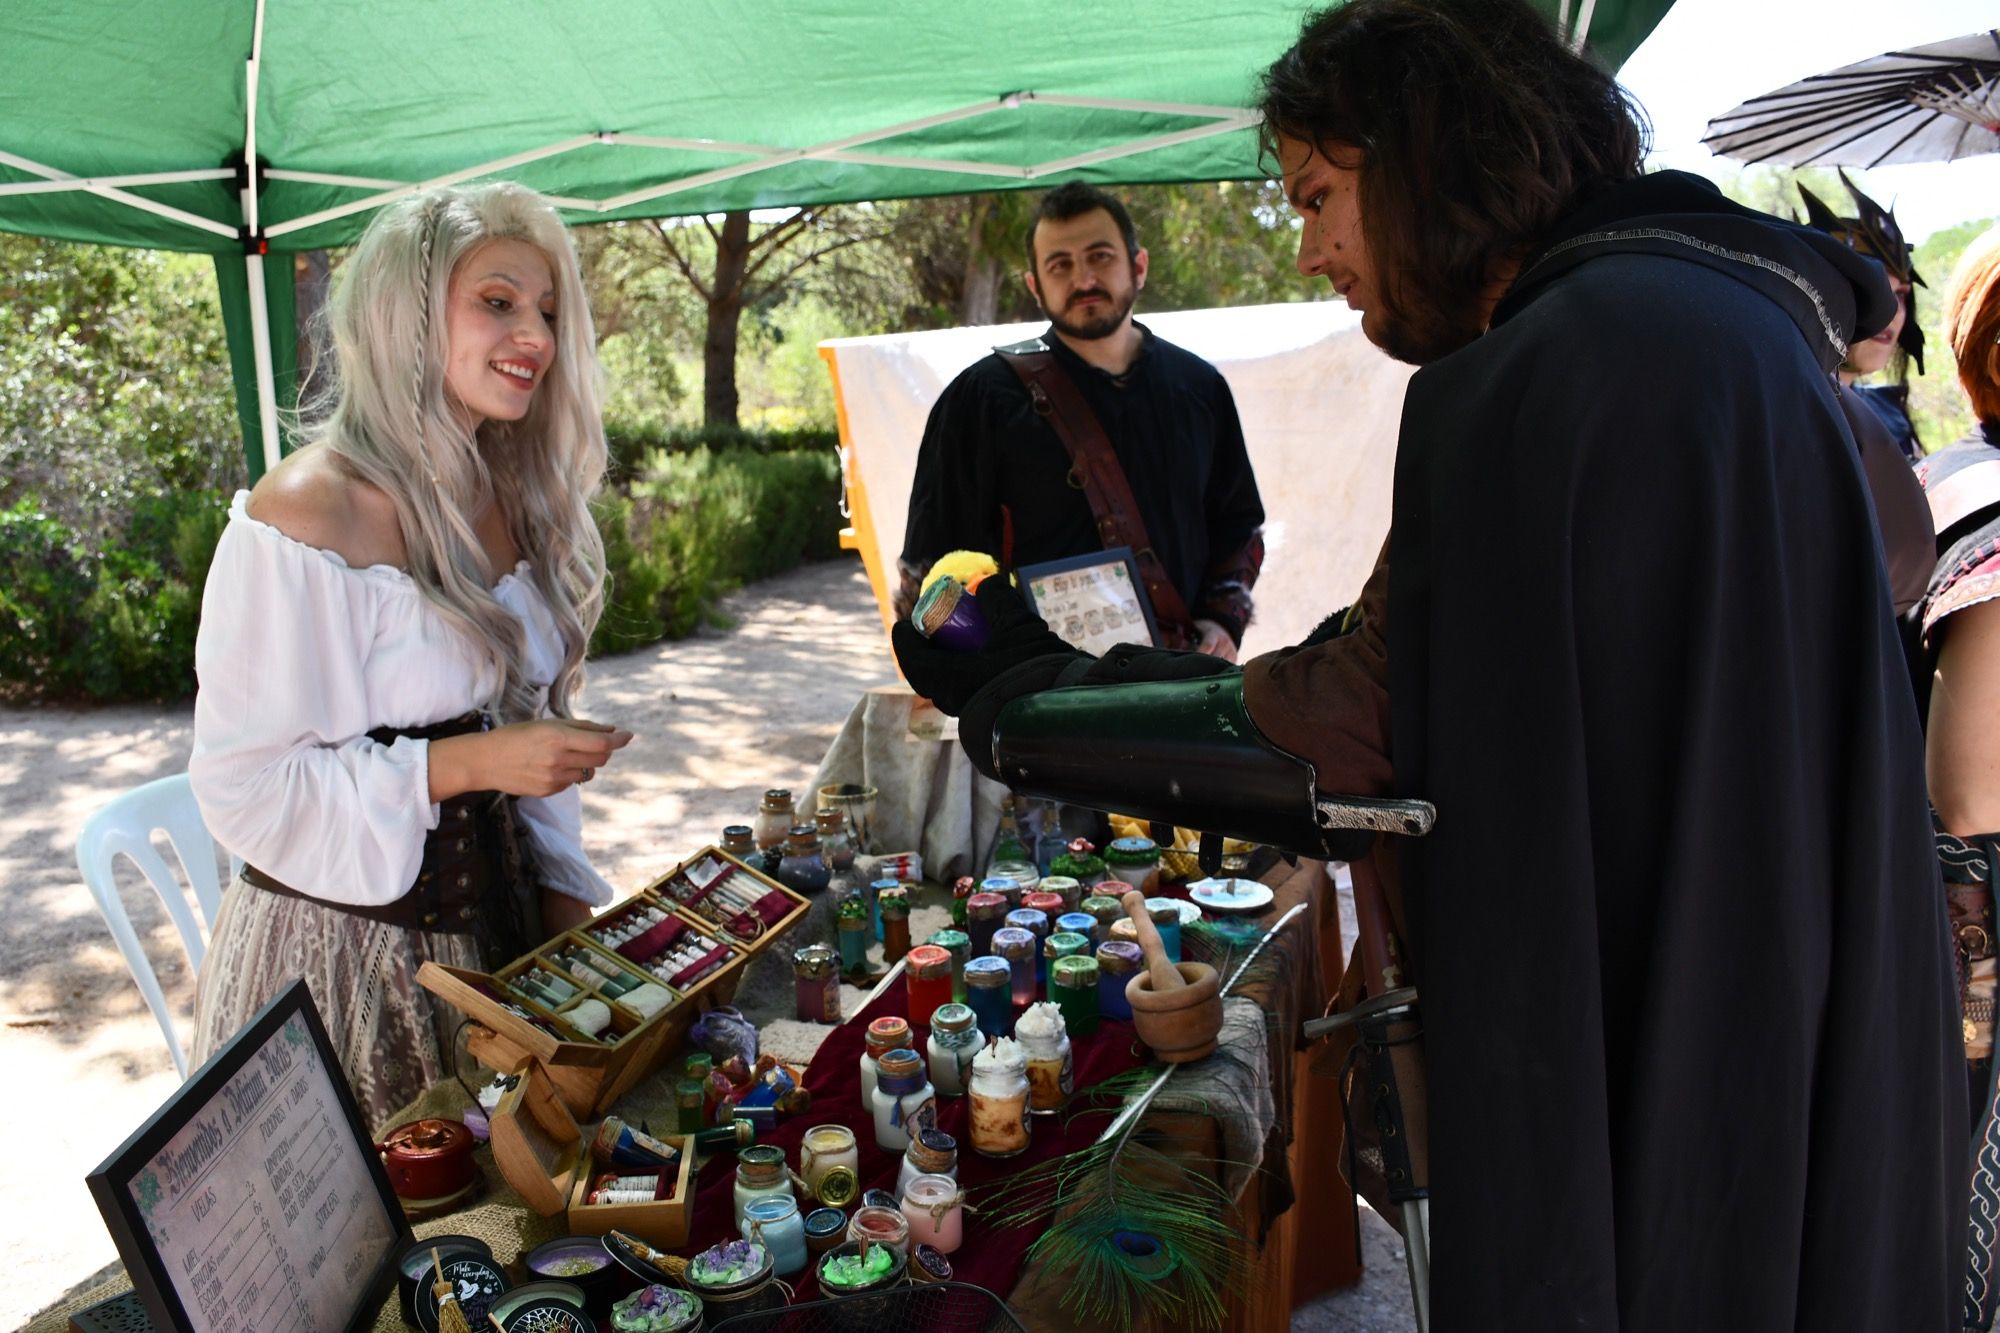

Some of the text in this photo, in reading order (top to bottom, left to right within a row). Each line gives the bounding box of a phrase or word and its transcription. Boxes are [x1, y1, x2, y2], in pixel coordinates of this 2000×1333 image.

[285, 1096, 292, 1112] Y
[291, 1076, 309, 1106] DADOS
[156, 1117, 224, 1201] Bienvenidos
[219, 1107, 233, 1136] a
[191, 1185, 217, 1223] VELAS
[278, 1185, 294, 1211] DADO
[291, 1168, 306, 1193] SETA
[285, 1200, 300, 1227] DADO
[297, 1174, 318, 1209] GRANDE
[315, 1188, 340, 1230] STICKERS
[182, 1247, 200, 1277] MIEL
[191, 1254, 218, 1297] BRUJAS
[453, 1262, 471, 1275] Make
[462, 1265, 490, 1281] everyday
[198, 1275, 223, 1315] ESCOBA
[208, 1295, 229, 1331] ABEJA
[237, 1281, 260, 1320] POTTER
